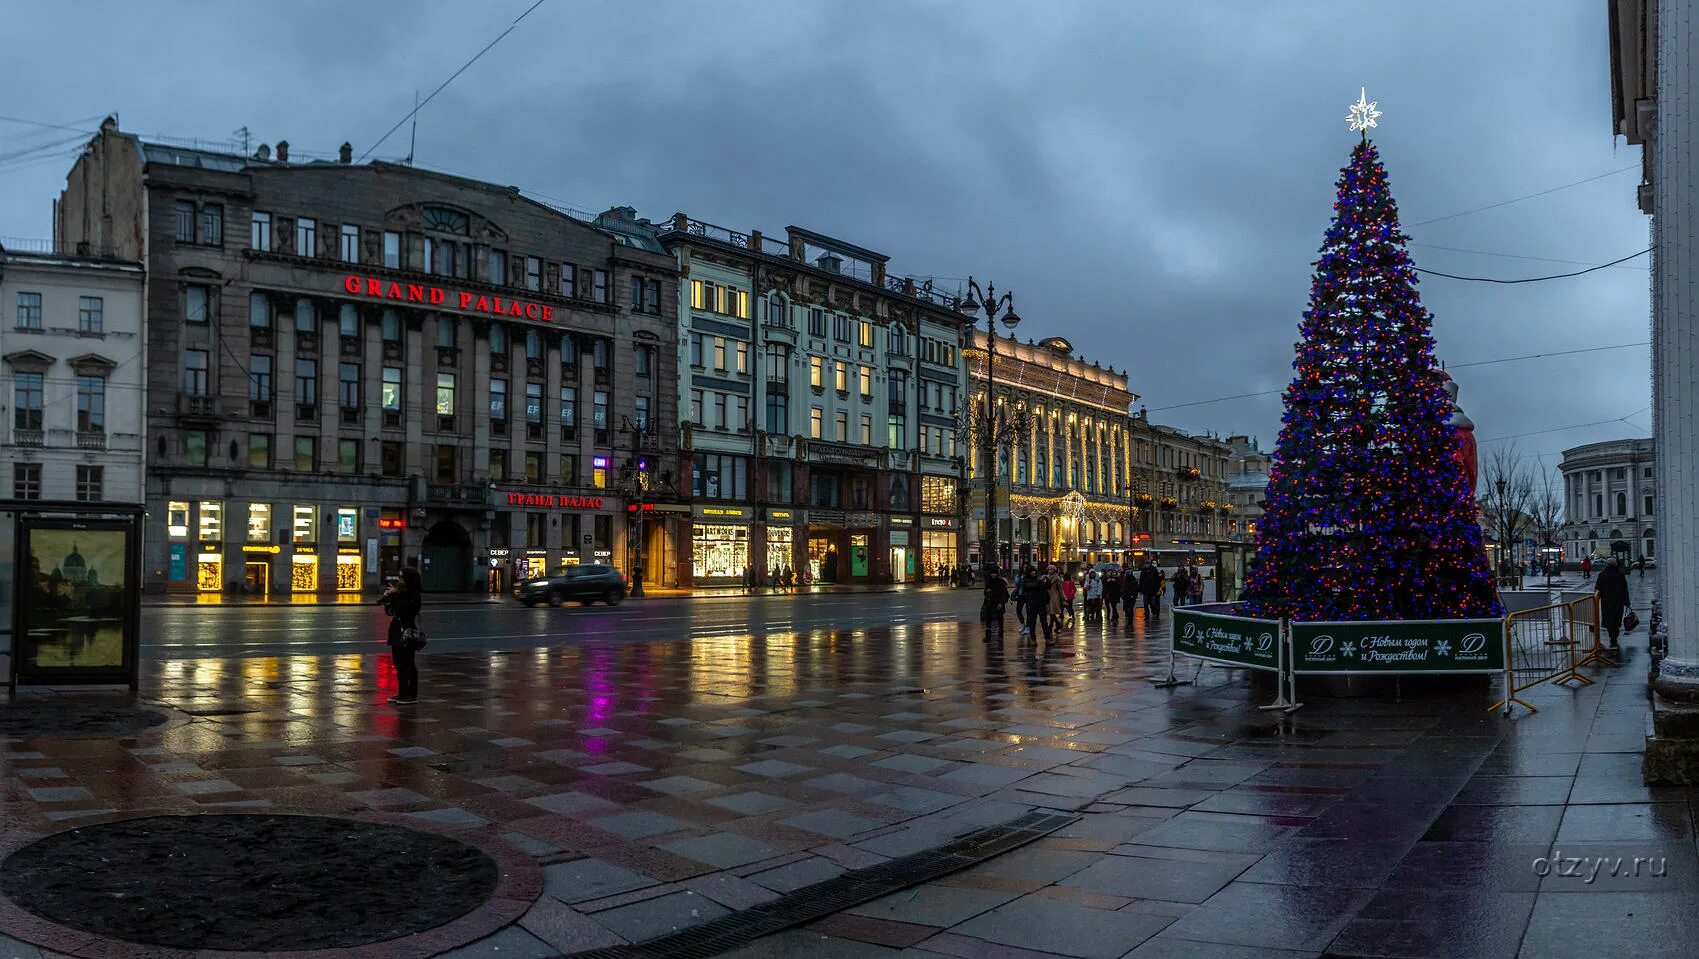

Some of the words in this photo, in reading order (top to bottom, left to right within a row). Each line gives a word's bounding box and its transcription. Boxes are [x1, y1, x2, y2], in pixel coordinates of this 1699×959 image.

[344, 275, 445, 304] GRAND
[459, 291, 554, 321] PALACE
[490, 401, 503, 410] EF
[528, 405, 540, 414] EF
[562, 408, 573, 417] EF
[508, 493, 553, 507] ГРАНД
[559, 496, 603, 508] ПАЛАС
[1360, 636, 1369, 648] С
[1369, 635, 1401, 649] Новым
[1404, 638, 1428, 649] годом
[1360, 653, 1368, 661] и
[1368, 648, 1429, 664] Рождеством!
